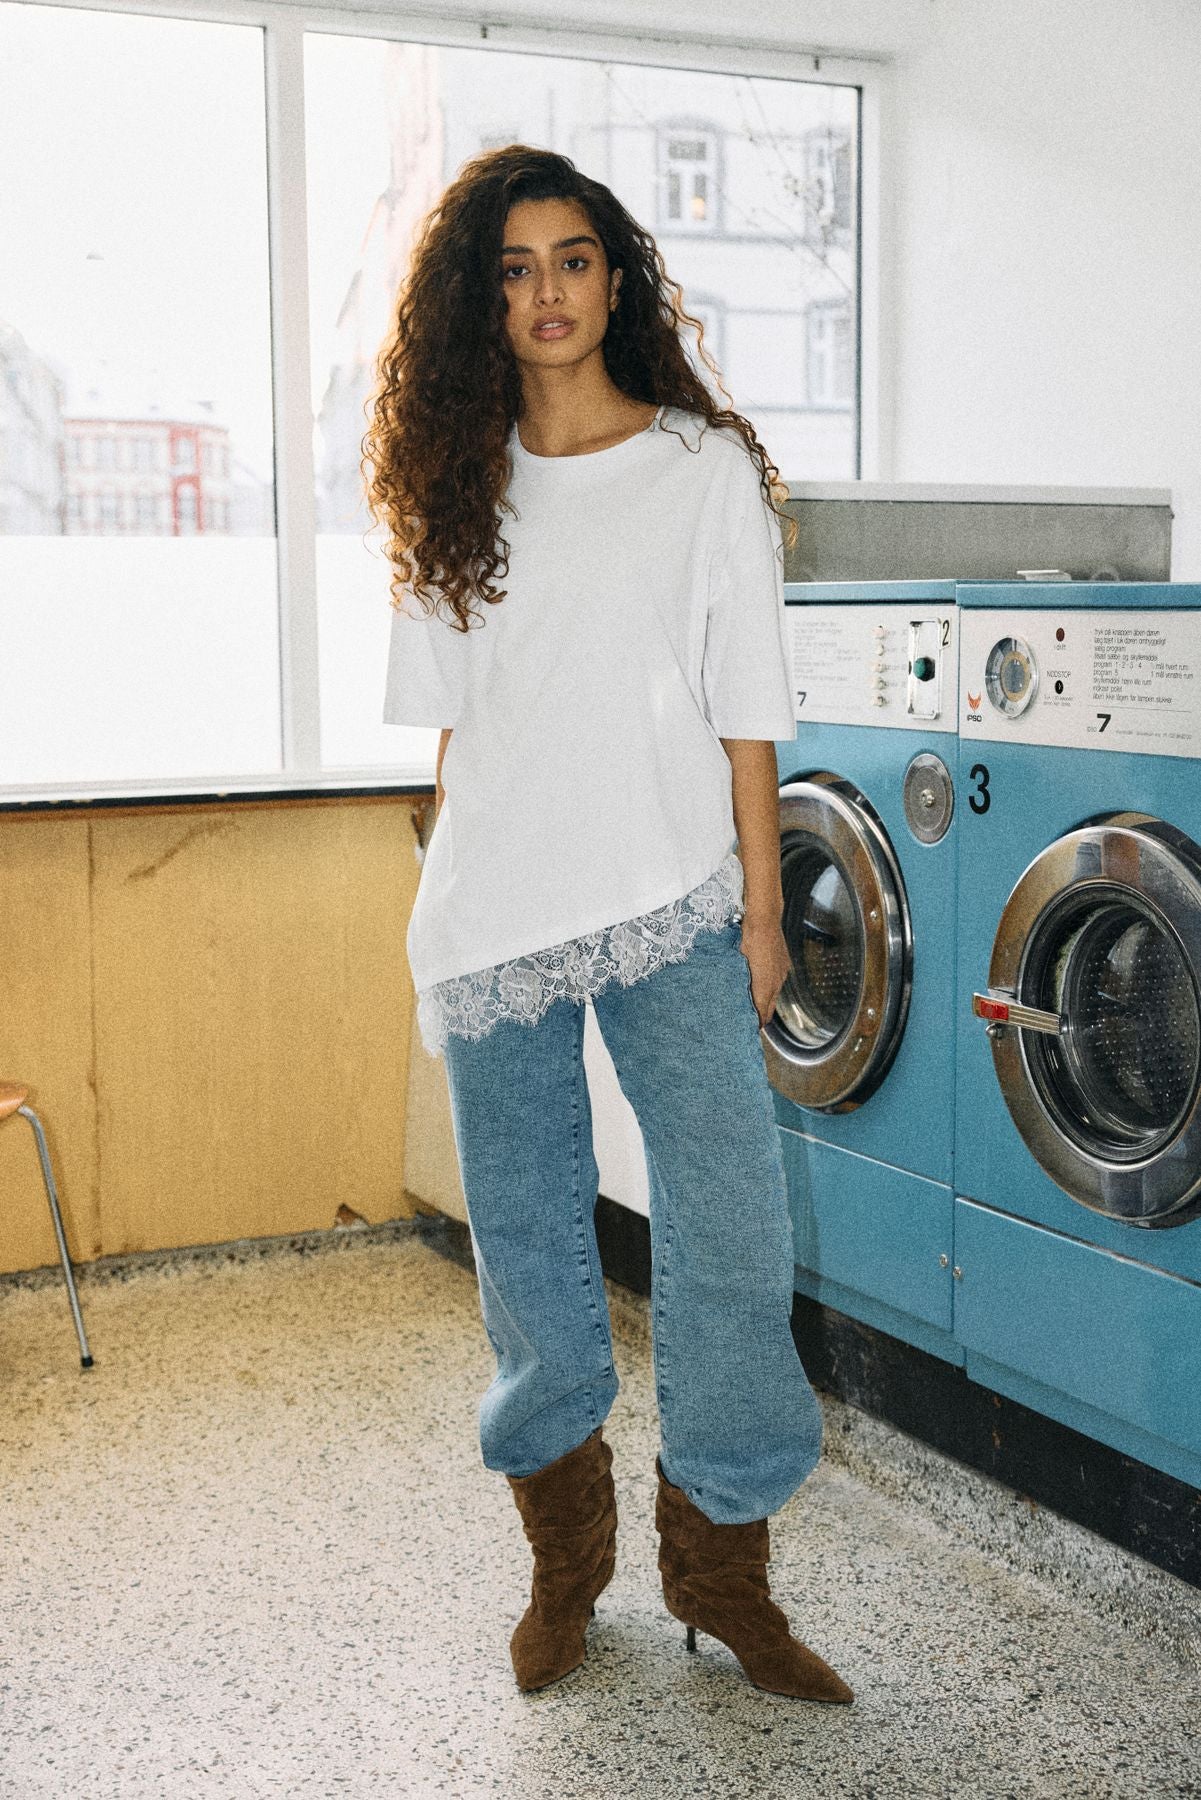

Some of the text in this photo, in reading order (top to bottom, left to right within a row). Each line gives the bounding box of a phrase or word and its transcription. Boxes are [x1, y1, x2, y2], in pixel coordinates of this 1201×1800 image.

[942, 619, 950, 647] 2
[1093, 661, 1112, 669] program
[1093, 669, 1112, 678] program
[797, 691, 807, 707] 7
[1096, 713, 1112, 733] 7
[969, 764, 991, 814] 3
